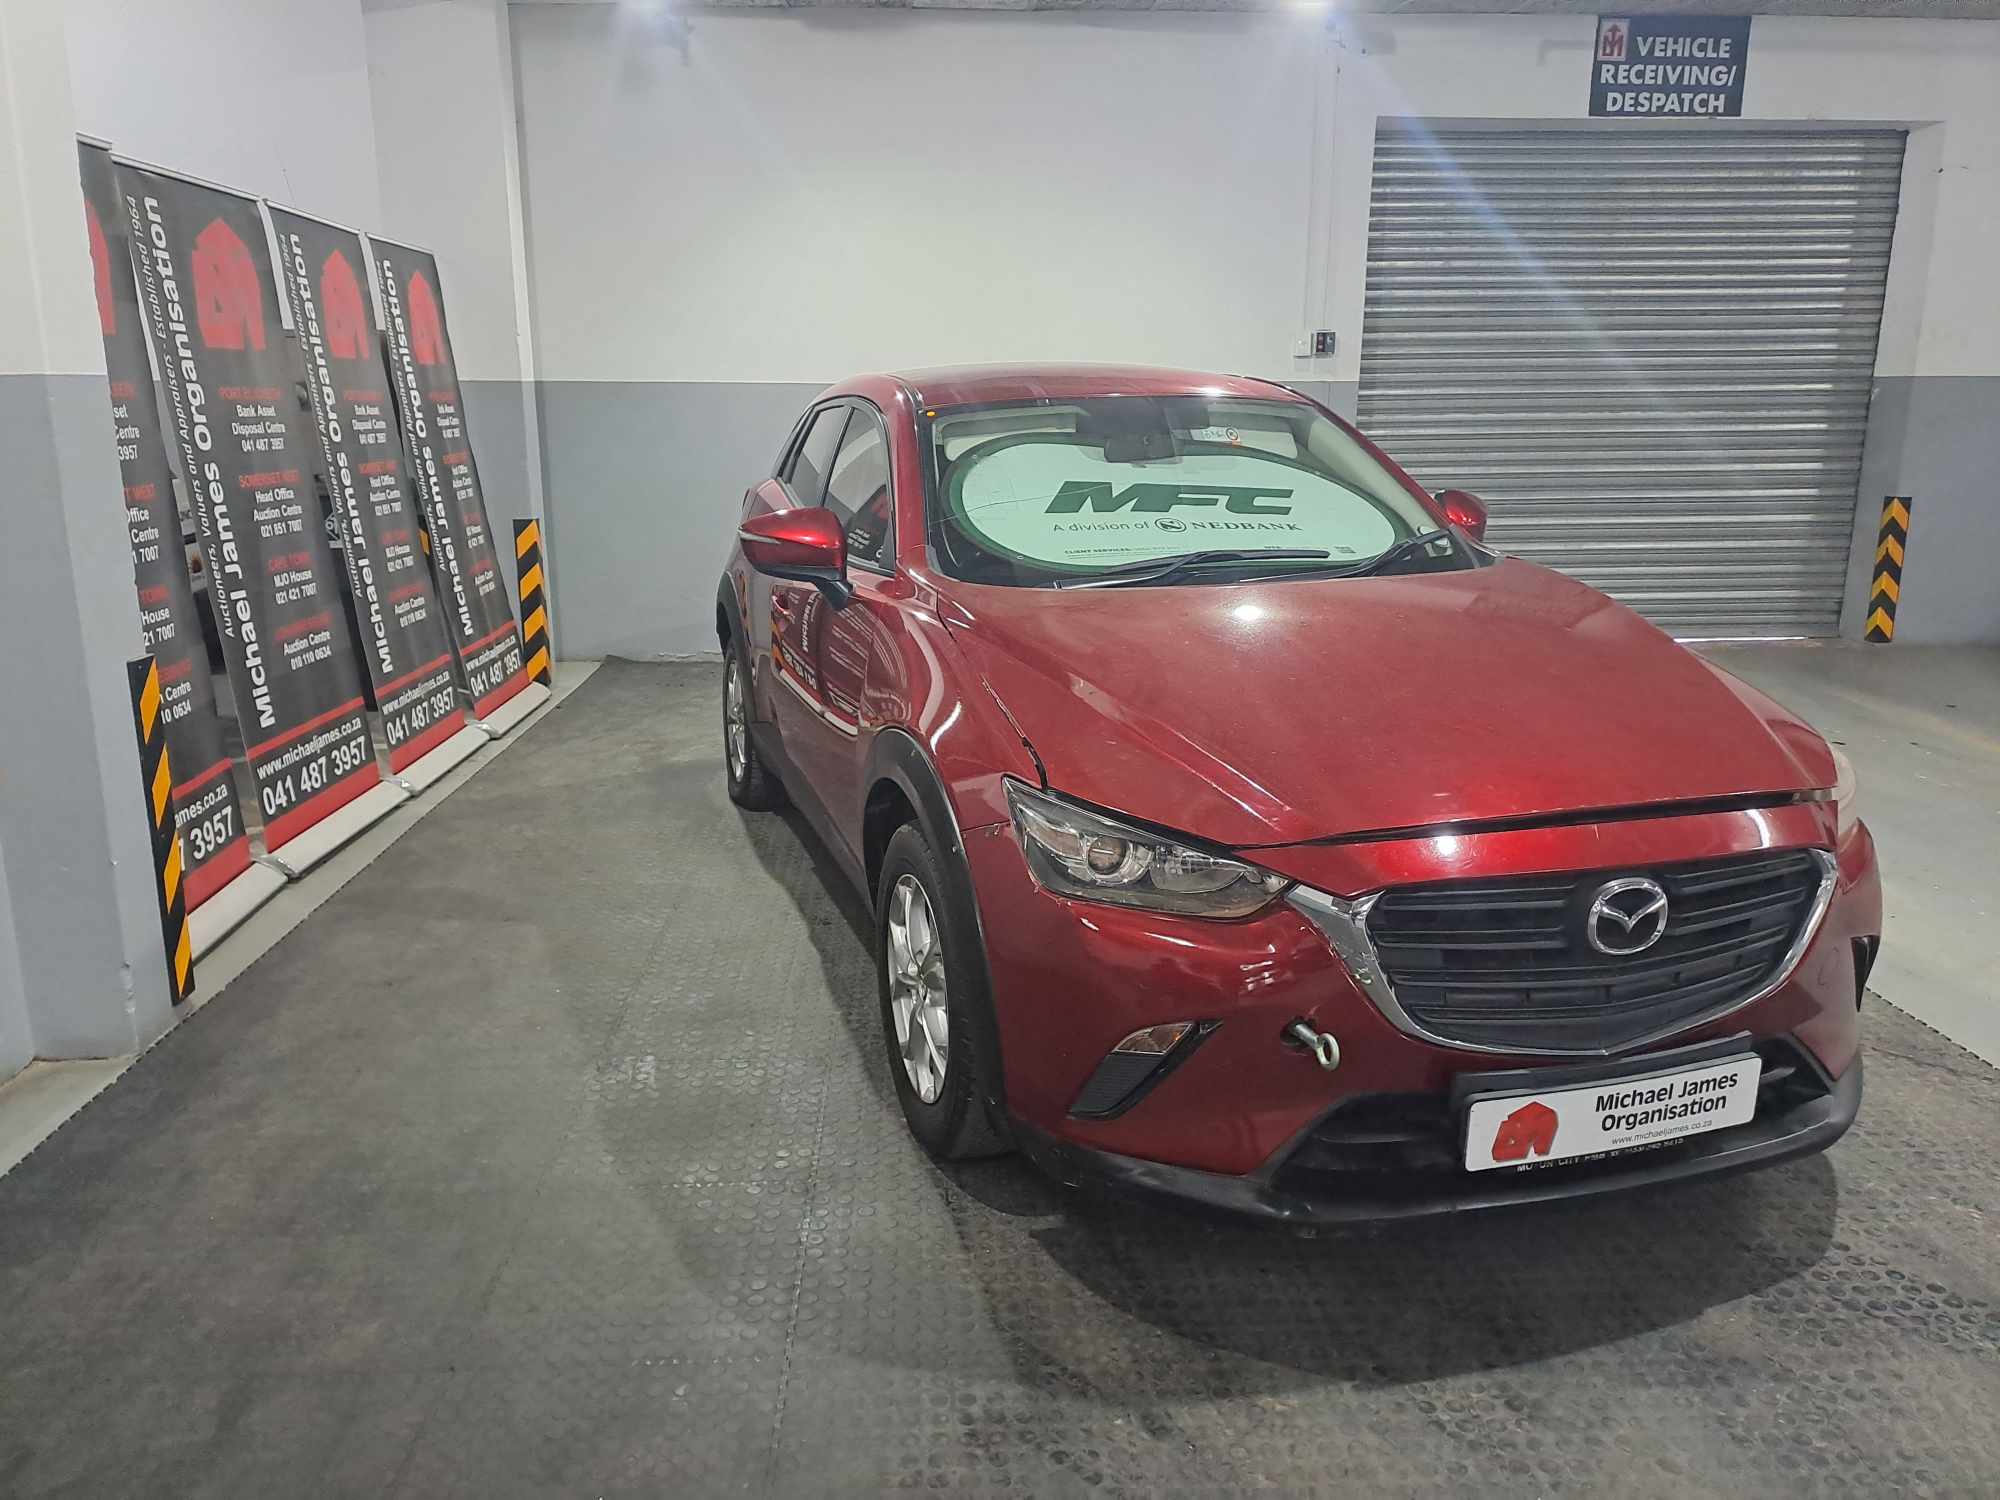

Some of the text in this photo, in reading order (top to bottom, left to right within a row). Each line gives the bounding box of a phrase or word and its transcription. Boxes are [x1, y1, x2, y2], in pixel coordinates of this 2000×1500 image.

[1637, 37, 1731, 58] VEHICLE
[1600, 64, 1737, 87] RECEIVING/
[1606, 92, 1725, 113] DESPATCH
[127, 195, 144, 239] 1964
[136, 242, 167, 339] Established
[289, 234, 342, 443] Organisation
[383, 260, 427, 438] Organisation
[164, 354, 190, 440] Appraisers
[236, 404, 256, 417] Bank
[232, 421, 265, 437] Disposal
[117, 445, 138, 461] 3957
[144, 196, 277, 730] Michael James Organisation
[181, 443, 198, 475] and
[321, 435, 333, 463] and
[255, 487, 295, 504] Head Office
[336, 452, 367, 550] James
[423, 446, 448, 530] James
[1044, 481, 1294, 515] MFC
[192, 479, 212, 537] Valuers
[253, 504, 302, 522] Auction Centre
[131, 527, 159, 543] Centre
[261, 525, 274, 538] 021
[274, 522, 287, 535] 851
[1053, 519, 1303, 532] A division of NEDBANK
[139, 545, 159, 564] 7007
[208, 542, 236, 638] Auctioneers,
[290, 570, 312, 584] House
[442, 537, 474, 636] Michael
[141, 607, 170, 626] House
[357, 558, 394, 674] Michael
[155, 623, 175, 643] 7007
[283, 630, 332, 657] Auction Centre
[470, 648, 521, 697] 041 487 3957
[165, 680, 192, 702] Centre
[172, 698, 192, 721] 0634
[386, 687, 454, 745] 041 487 3957
[257, 716, 362, 781] www.michaeljames.co.za
[262, 735, 367, 816] 041 487 3957
[190, 805, 235, 860] 3957
[1595, 1071, 1738, 1113] Michael James
[1601, 1093, 1727, 1132] Organisation
